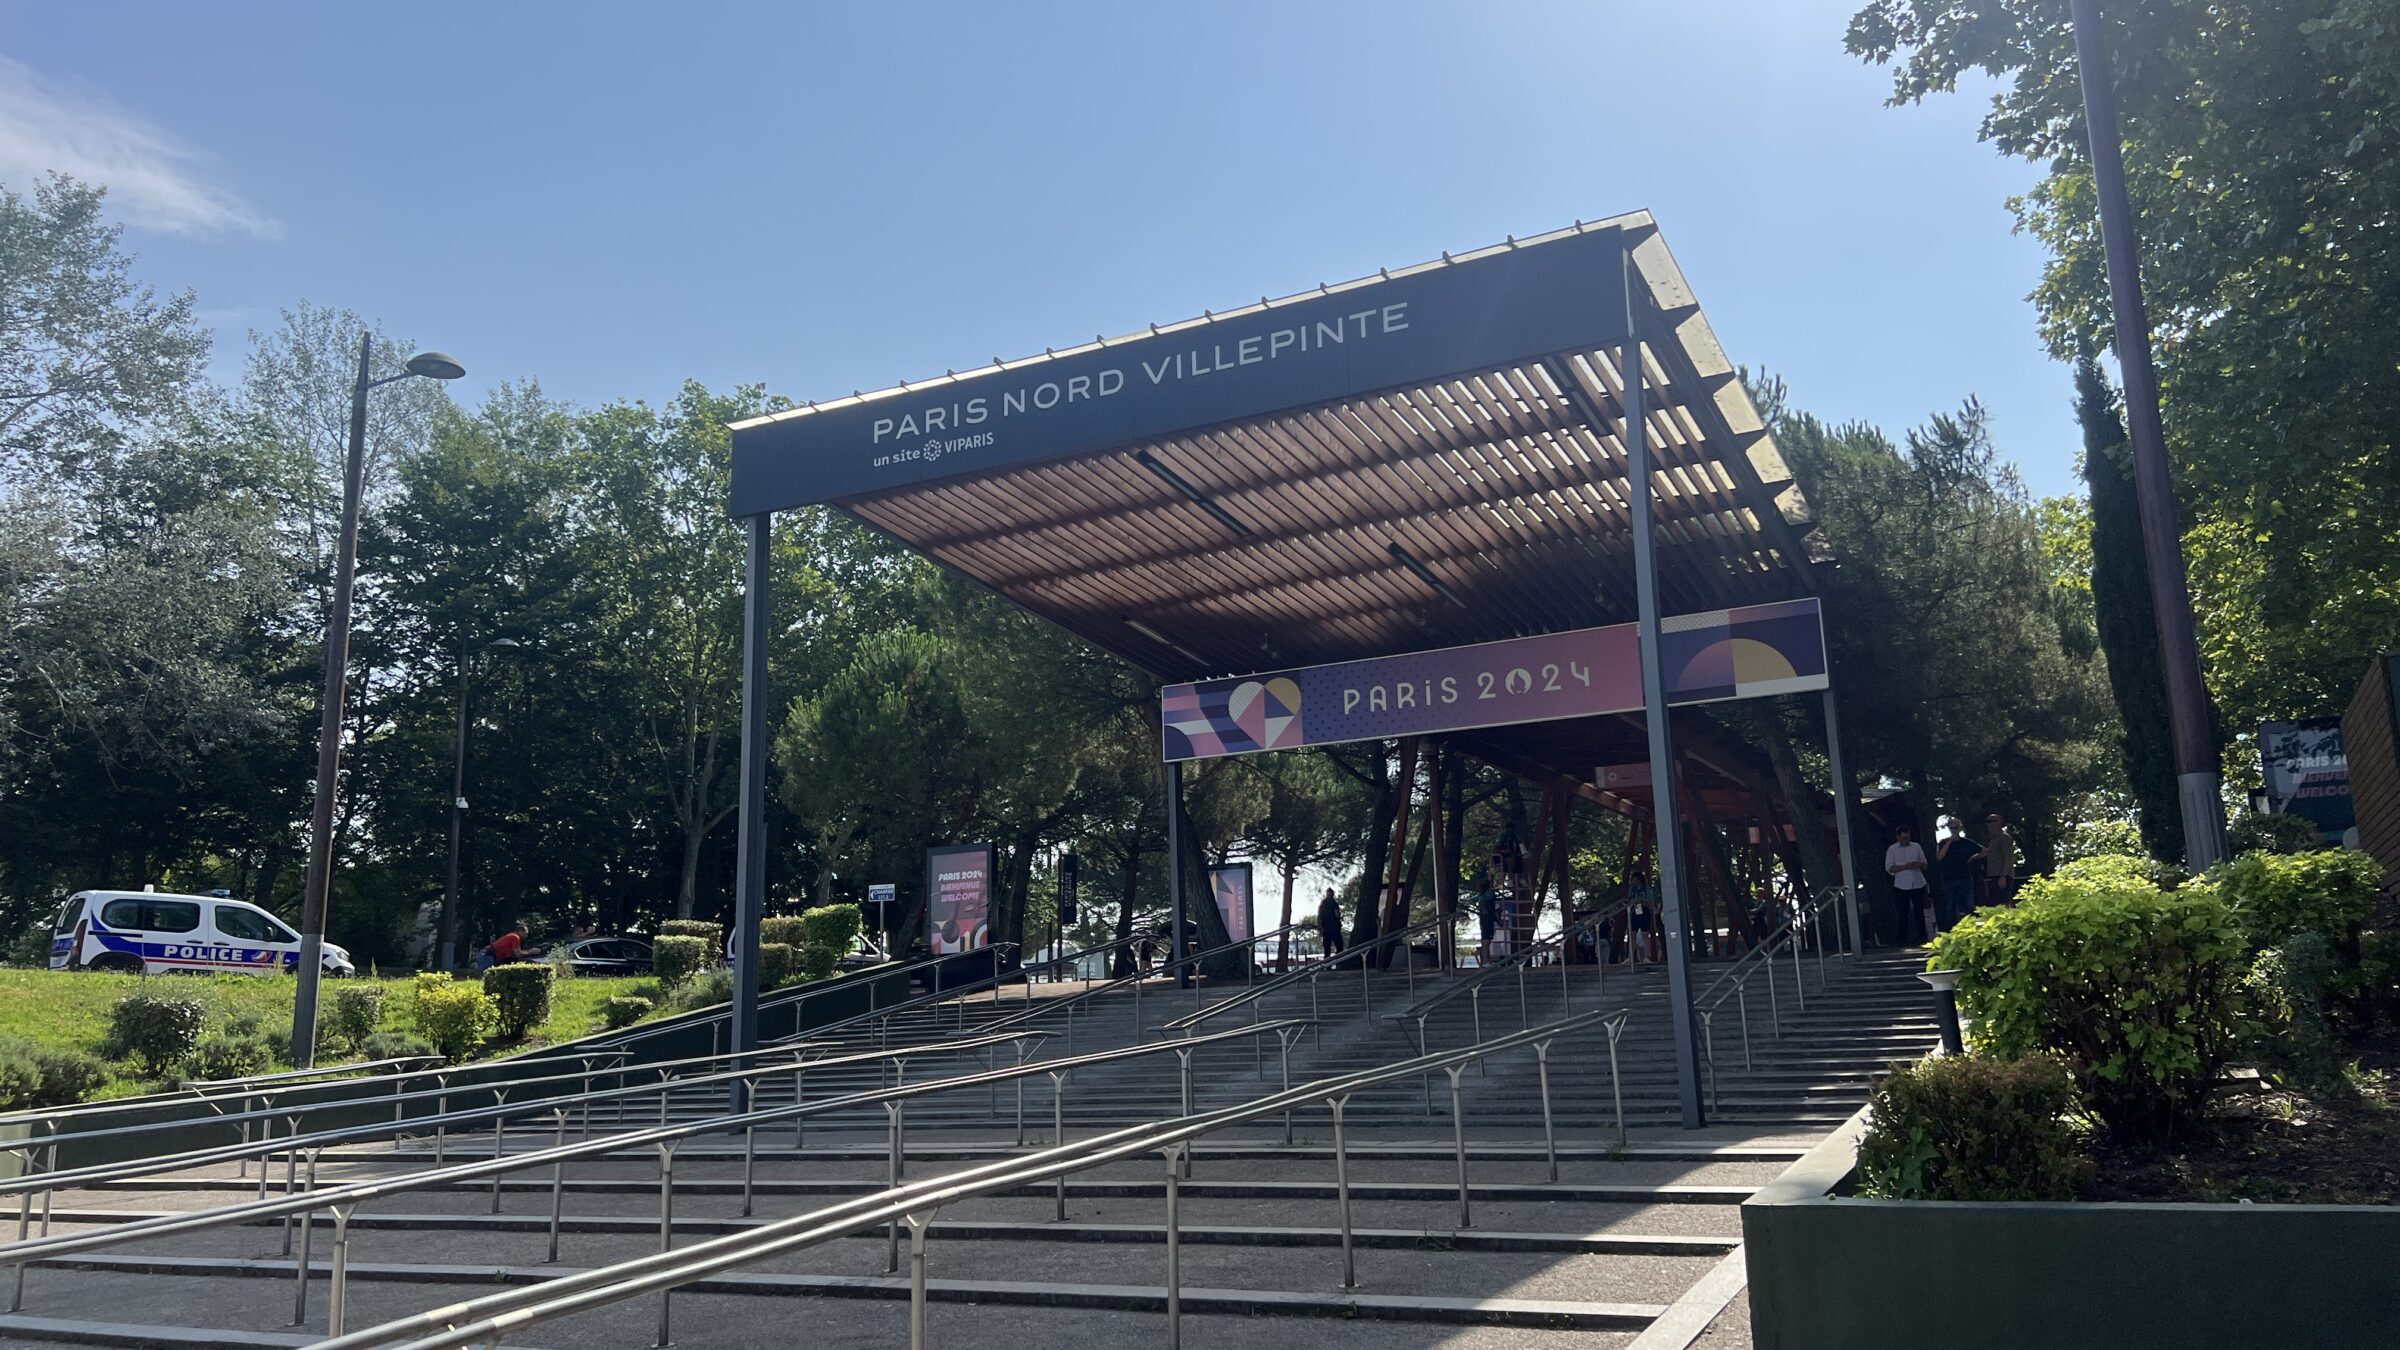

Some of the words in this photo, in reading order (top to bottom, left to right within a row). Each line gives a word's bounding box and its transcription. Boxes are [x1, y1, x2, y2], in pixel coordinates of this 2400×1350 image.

[873, 398, 988, 444] PARIS
[1003, 369, 1124, 417] NORD
[1142, 302, 1409, 385] VILLEPINTE
[873, 455, 890, 467] un
[892, 448, 921, 464] site
[944, 432, 994, 454] VIPARIS
[1477, 661, 1590, 700] 2024
[2296, 785, 2350, 798] WELCO
[938, 872, 960, 881] PARIS
[961, 870, 983, 880] 2024
[940, 881, 980, 892] BIENVENUE
[941, 892, 980, 902] WELCOME
[163, 945, 243, 961] POLICE
